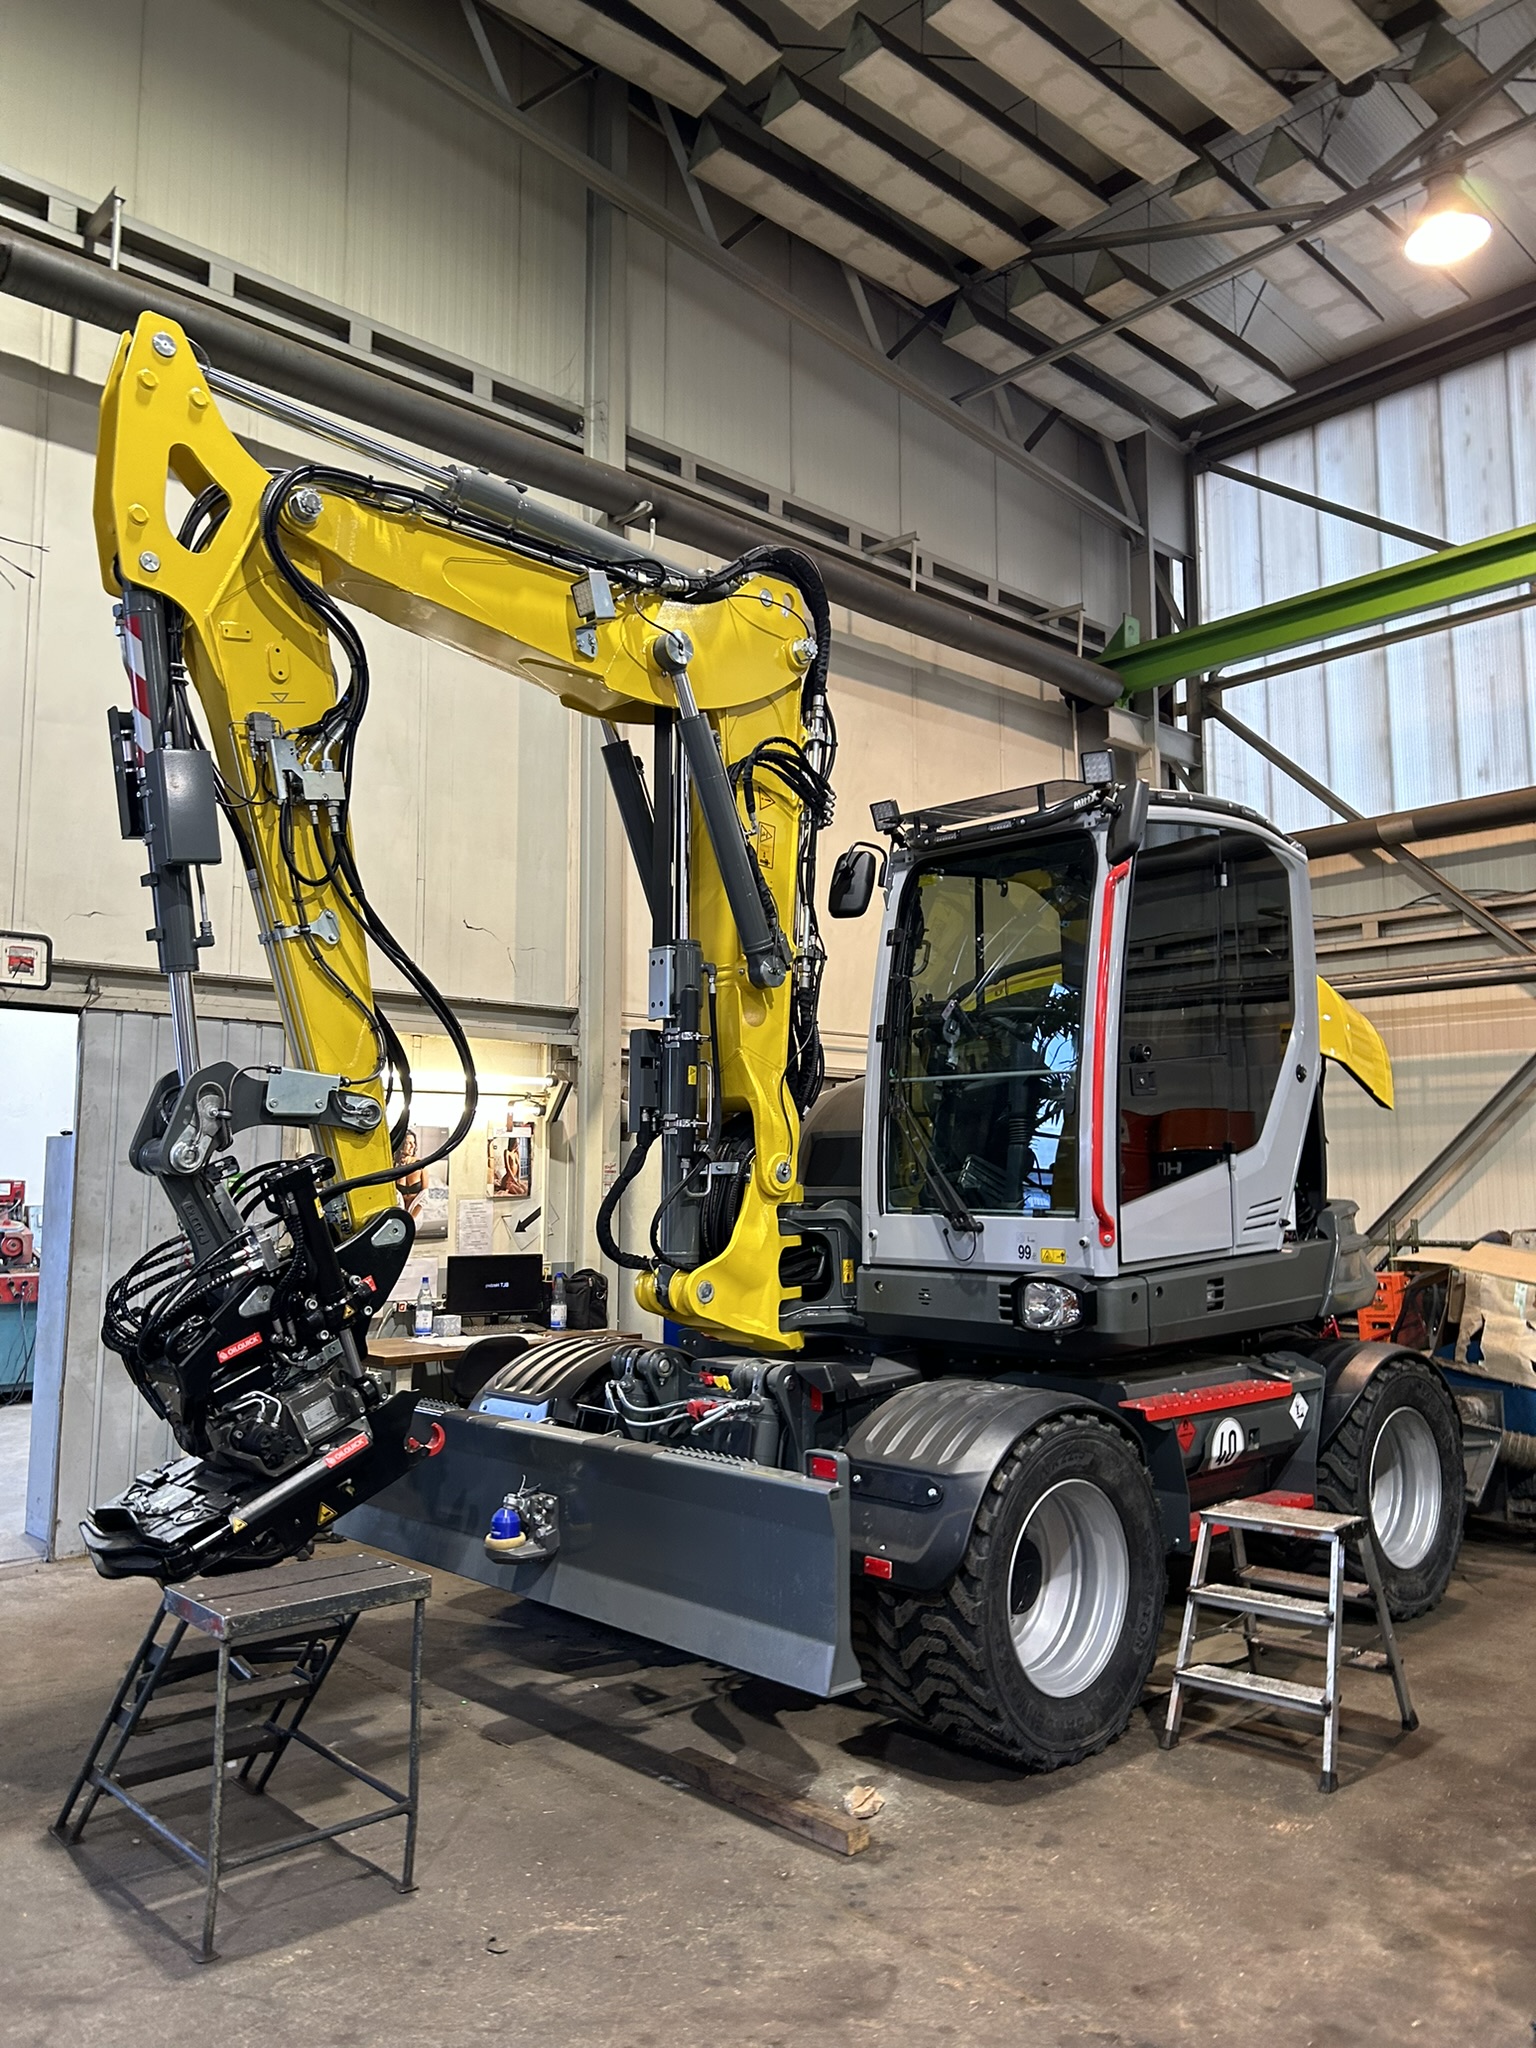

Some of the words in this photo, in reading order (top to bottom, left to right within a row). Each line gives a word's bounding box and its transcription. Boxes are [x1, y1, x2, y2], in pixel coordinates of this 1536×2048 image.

[1018, 1244, 1031, 1260] 99
[227, 1336, 259, 1356] OILQUICK
[334, 1438, 365, 1460] OILQUICK
[1215, 1429, 1237, 1466] 40
